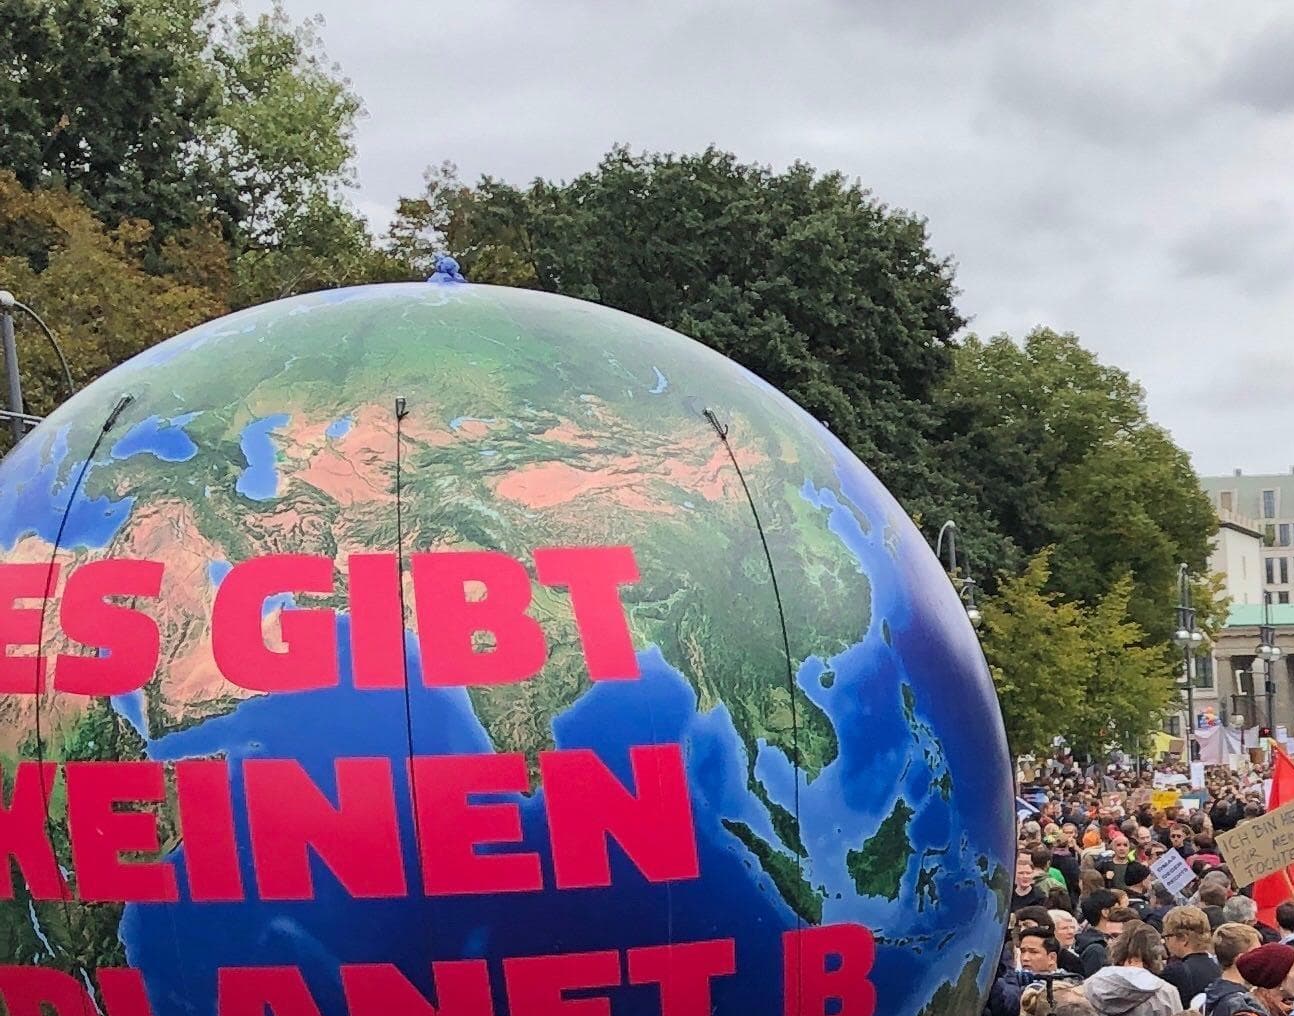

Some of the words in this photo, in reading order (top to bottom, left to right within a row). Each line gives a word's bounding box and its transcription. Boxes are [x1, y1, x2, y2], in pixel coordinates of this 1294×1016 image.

[0, 559, 165, 696] ES
[212, 546, 639, 692] GIBT
[0, 745, 698, 902] KEINEN
[1222, 833, 1251, 852] ICH
[1252, 816, 1278, 838] BIN
